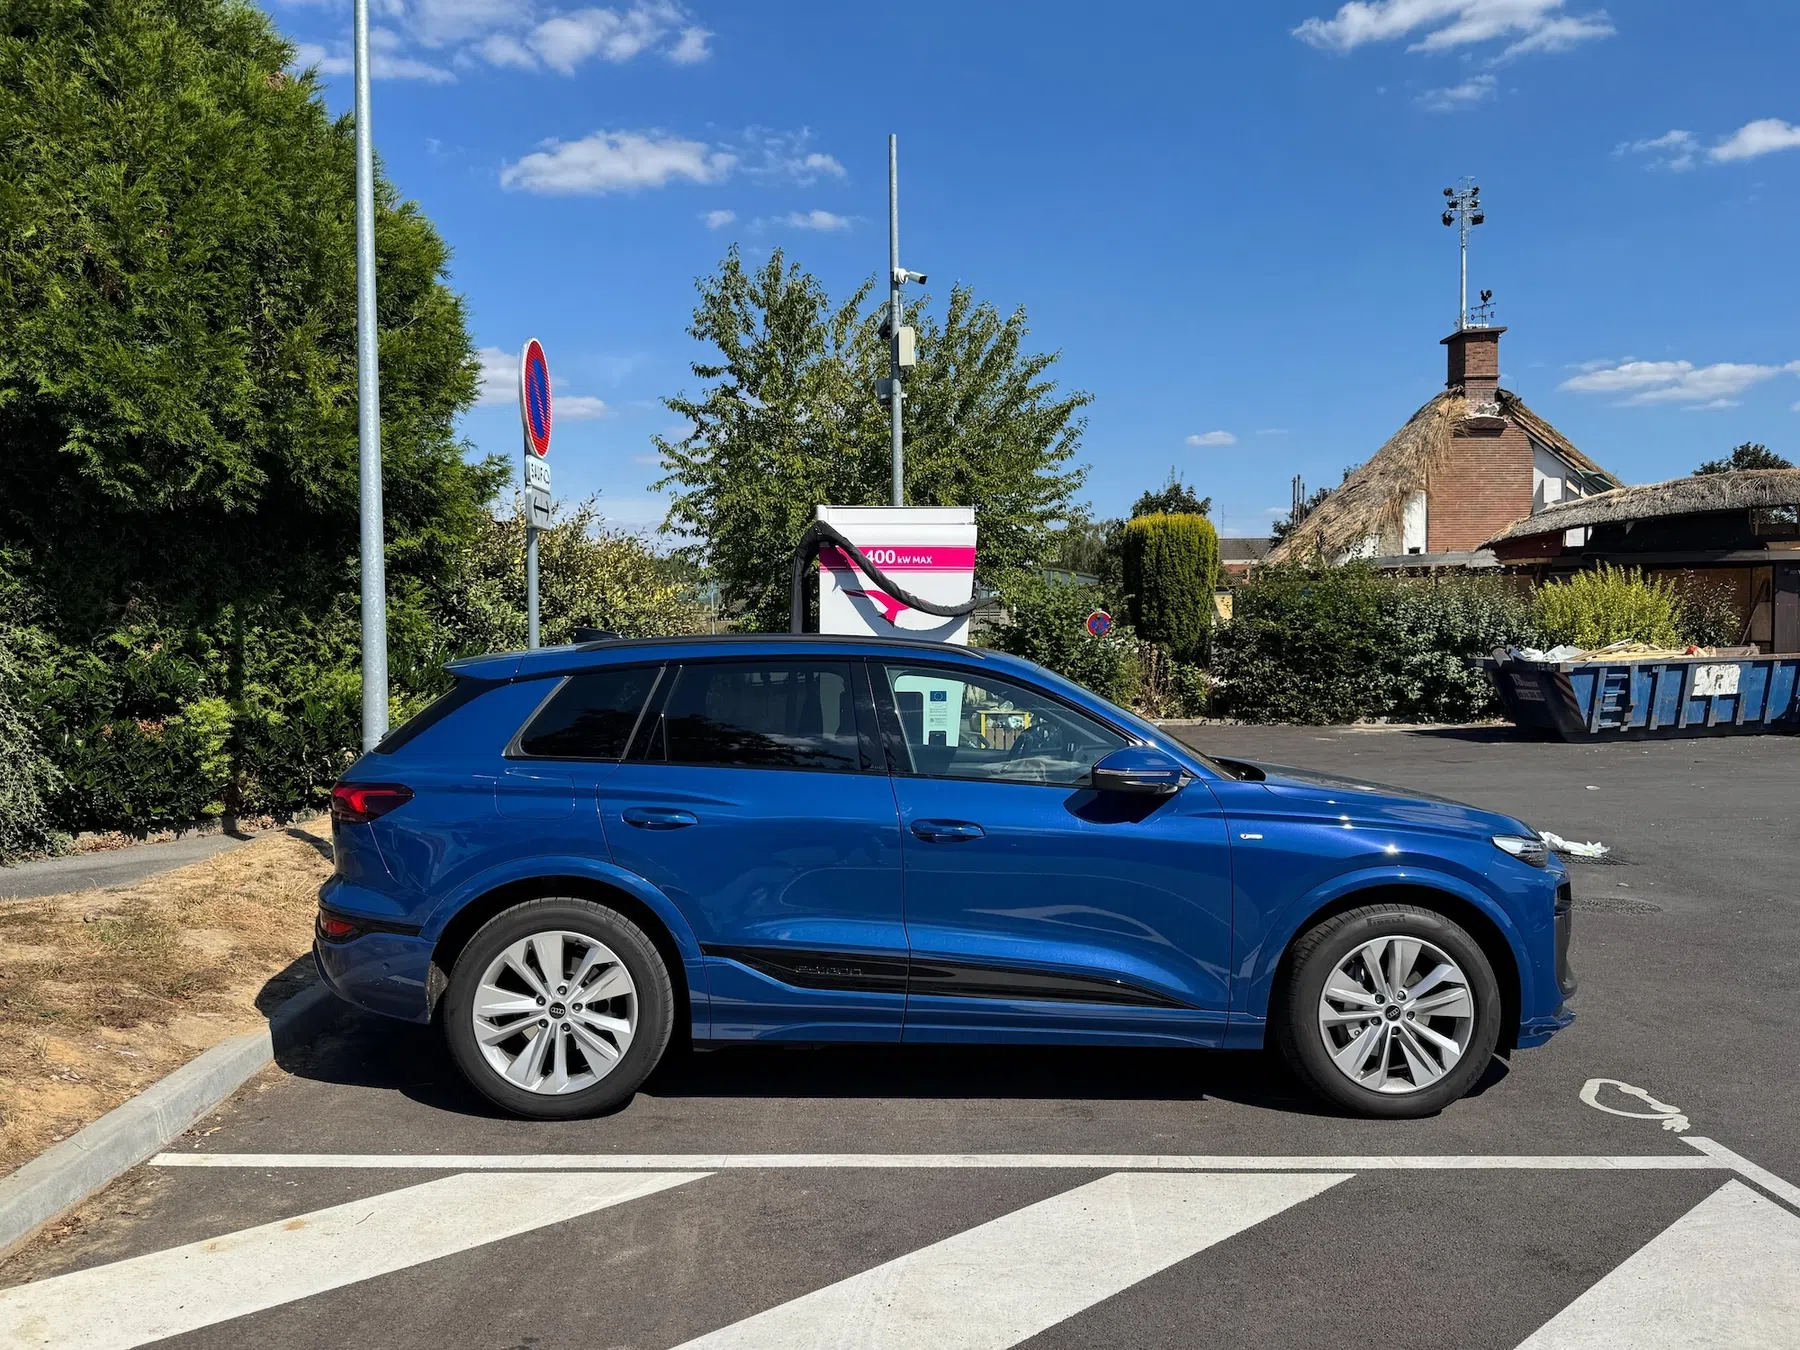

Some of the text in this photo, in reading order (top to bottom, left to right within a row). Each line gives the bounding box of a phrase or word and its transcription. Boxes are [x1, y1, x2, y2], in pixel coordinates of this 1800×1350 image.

[865, 549, 933, 564] 400 kW MAX
